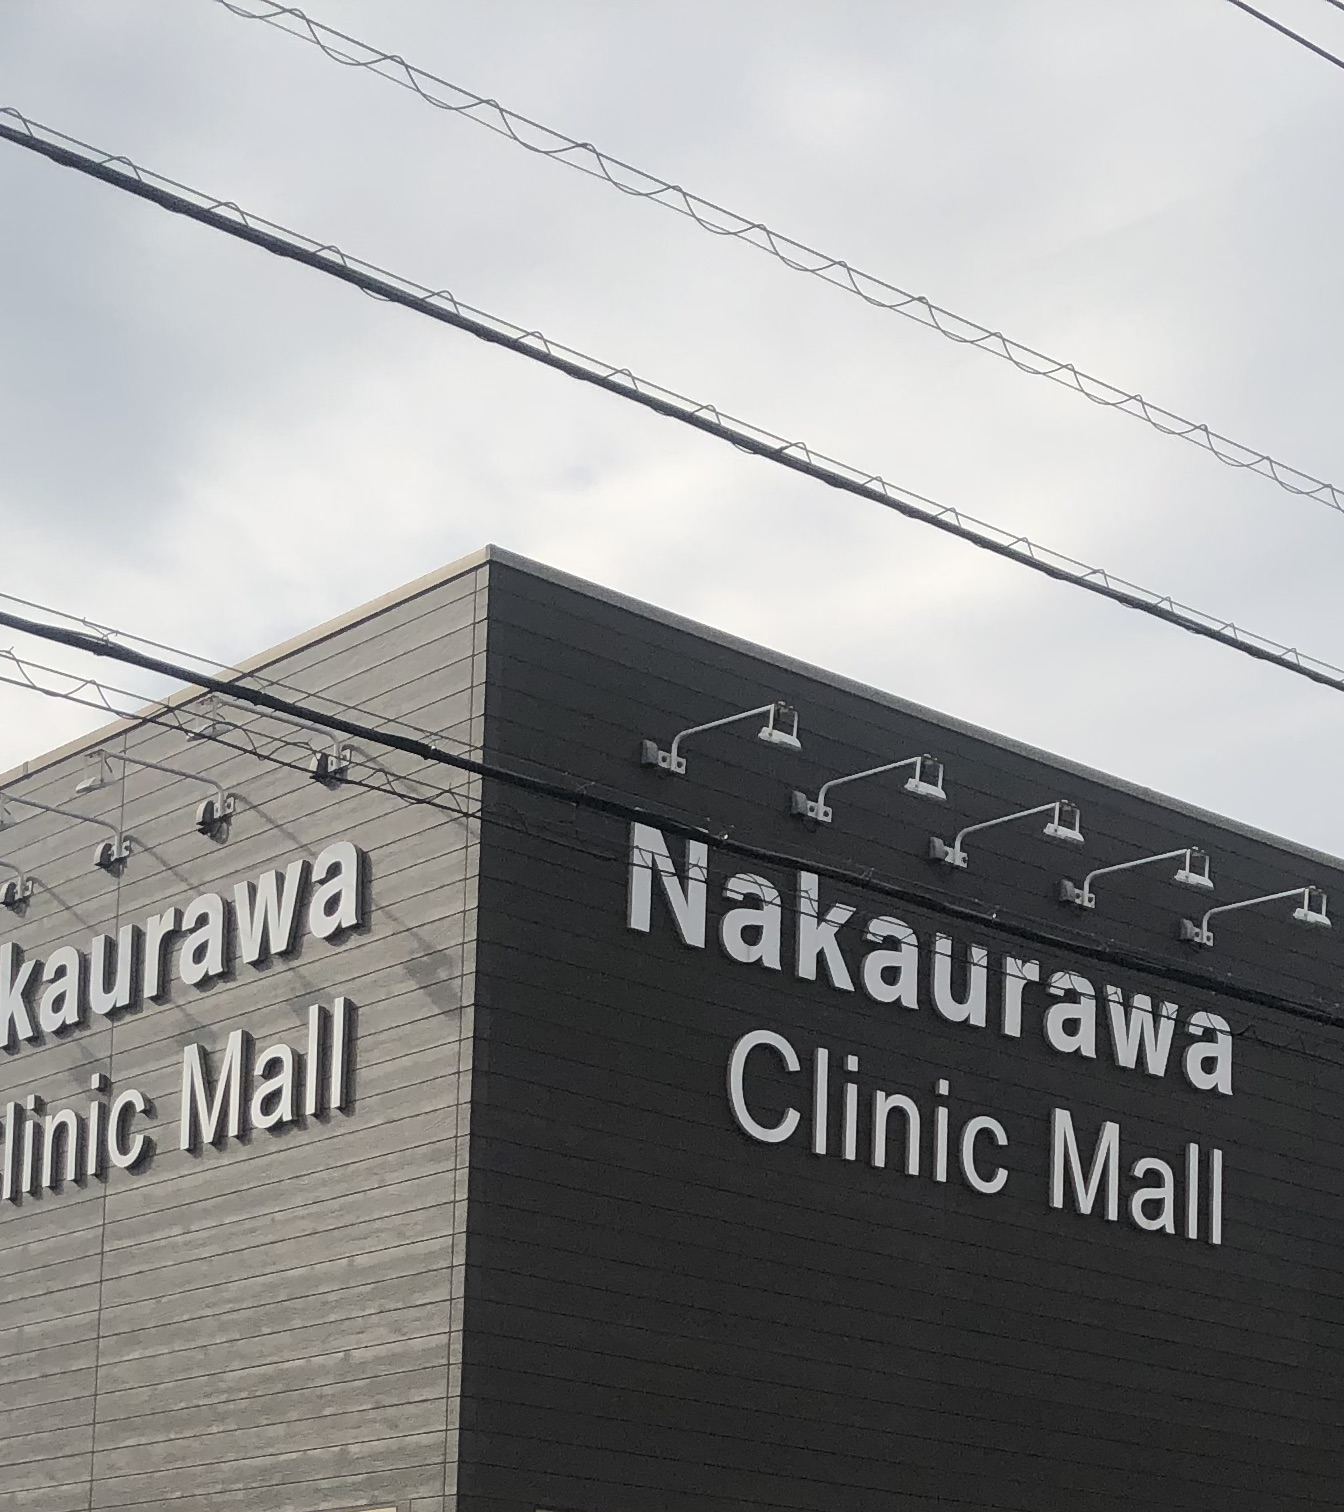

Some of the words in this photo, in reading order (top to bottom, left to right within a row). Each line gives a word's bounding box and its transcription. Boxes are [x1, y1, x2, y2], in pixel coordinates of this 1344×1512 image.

[627, 822, 1233, 1095] Nakaurawa
[180, 997, 349, 1151] Mall
[728, 1030, 1009, 1193] Clinic
[1050, 1107, 1222, 1245] Mall
